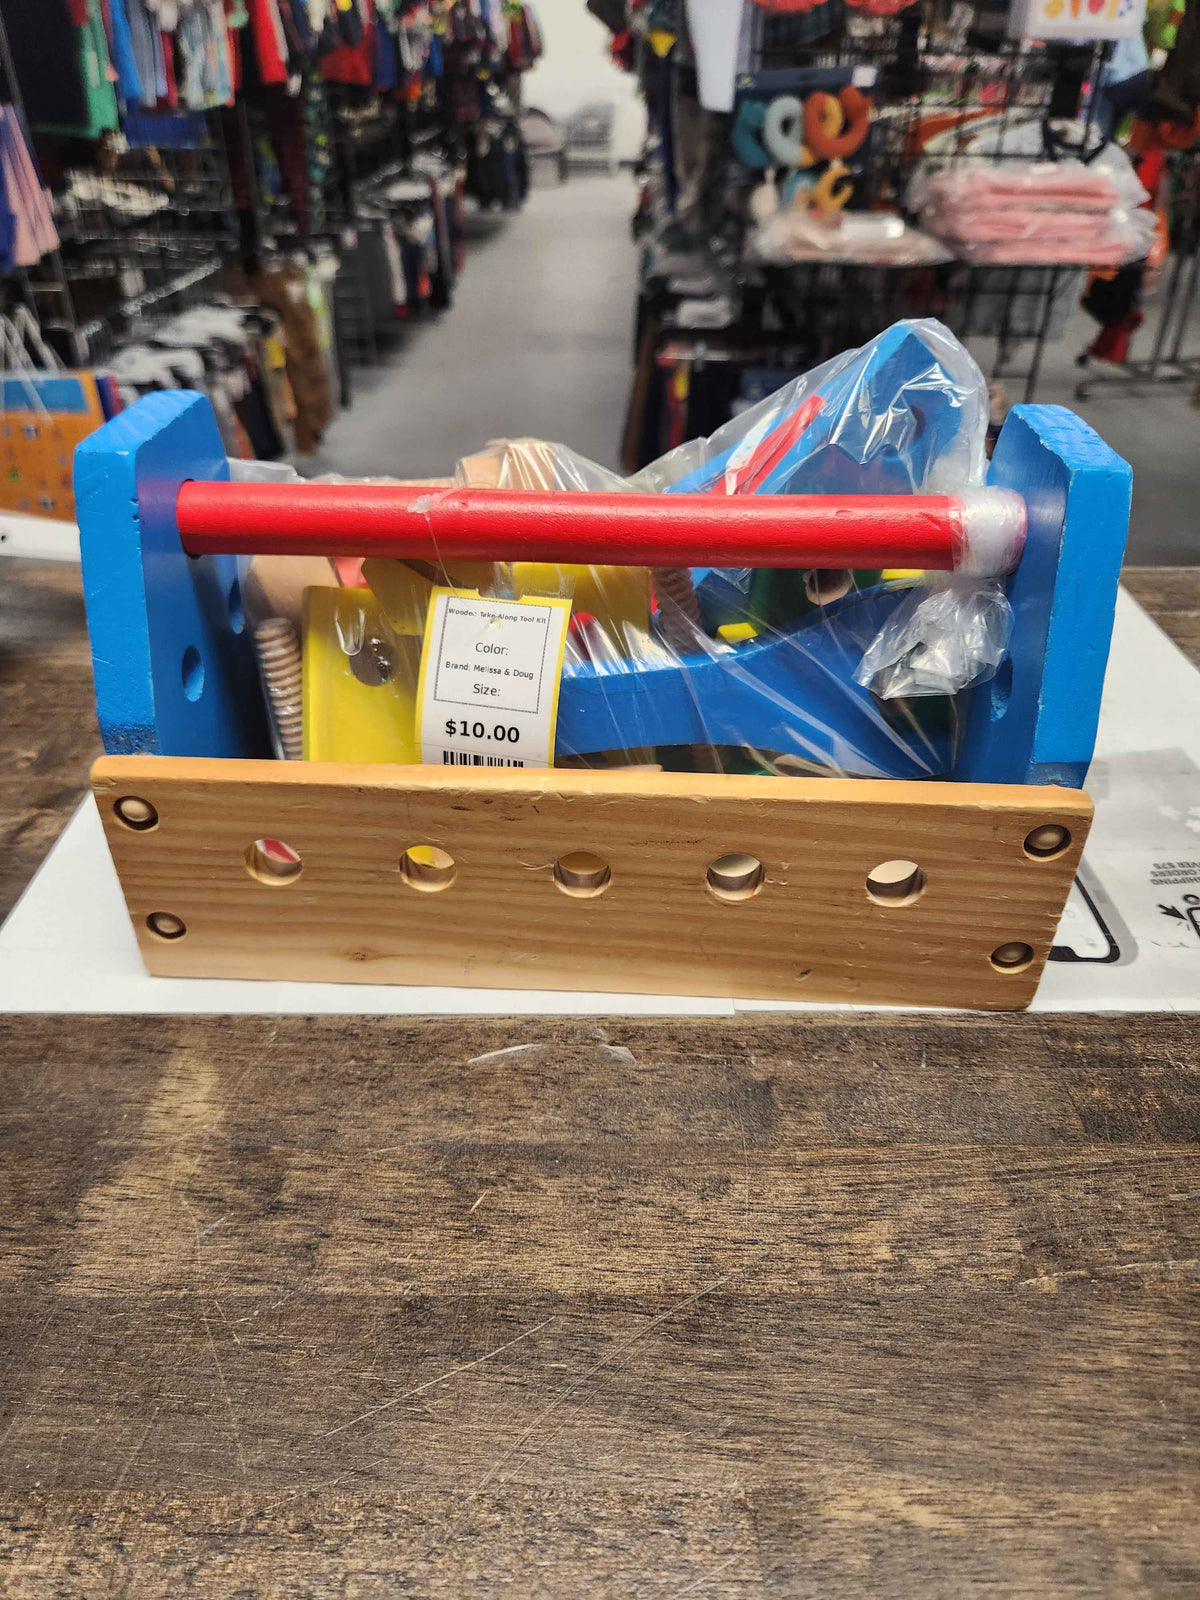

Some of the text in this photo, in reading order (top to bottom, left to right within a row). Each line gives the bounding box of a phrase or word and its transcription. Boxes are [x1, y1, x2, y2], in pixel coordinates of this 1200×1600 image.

[480, 611, 518, 622] Take-Along
[520, 615, 535, 623] Tool
[475, 642, 509, 656] Color:
[445, 661, 534, 681] Brand: Melissa & Doug
[472, 683, 501, 697] Size:
[445, 718, 520, 743] $10.00
